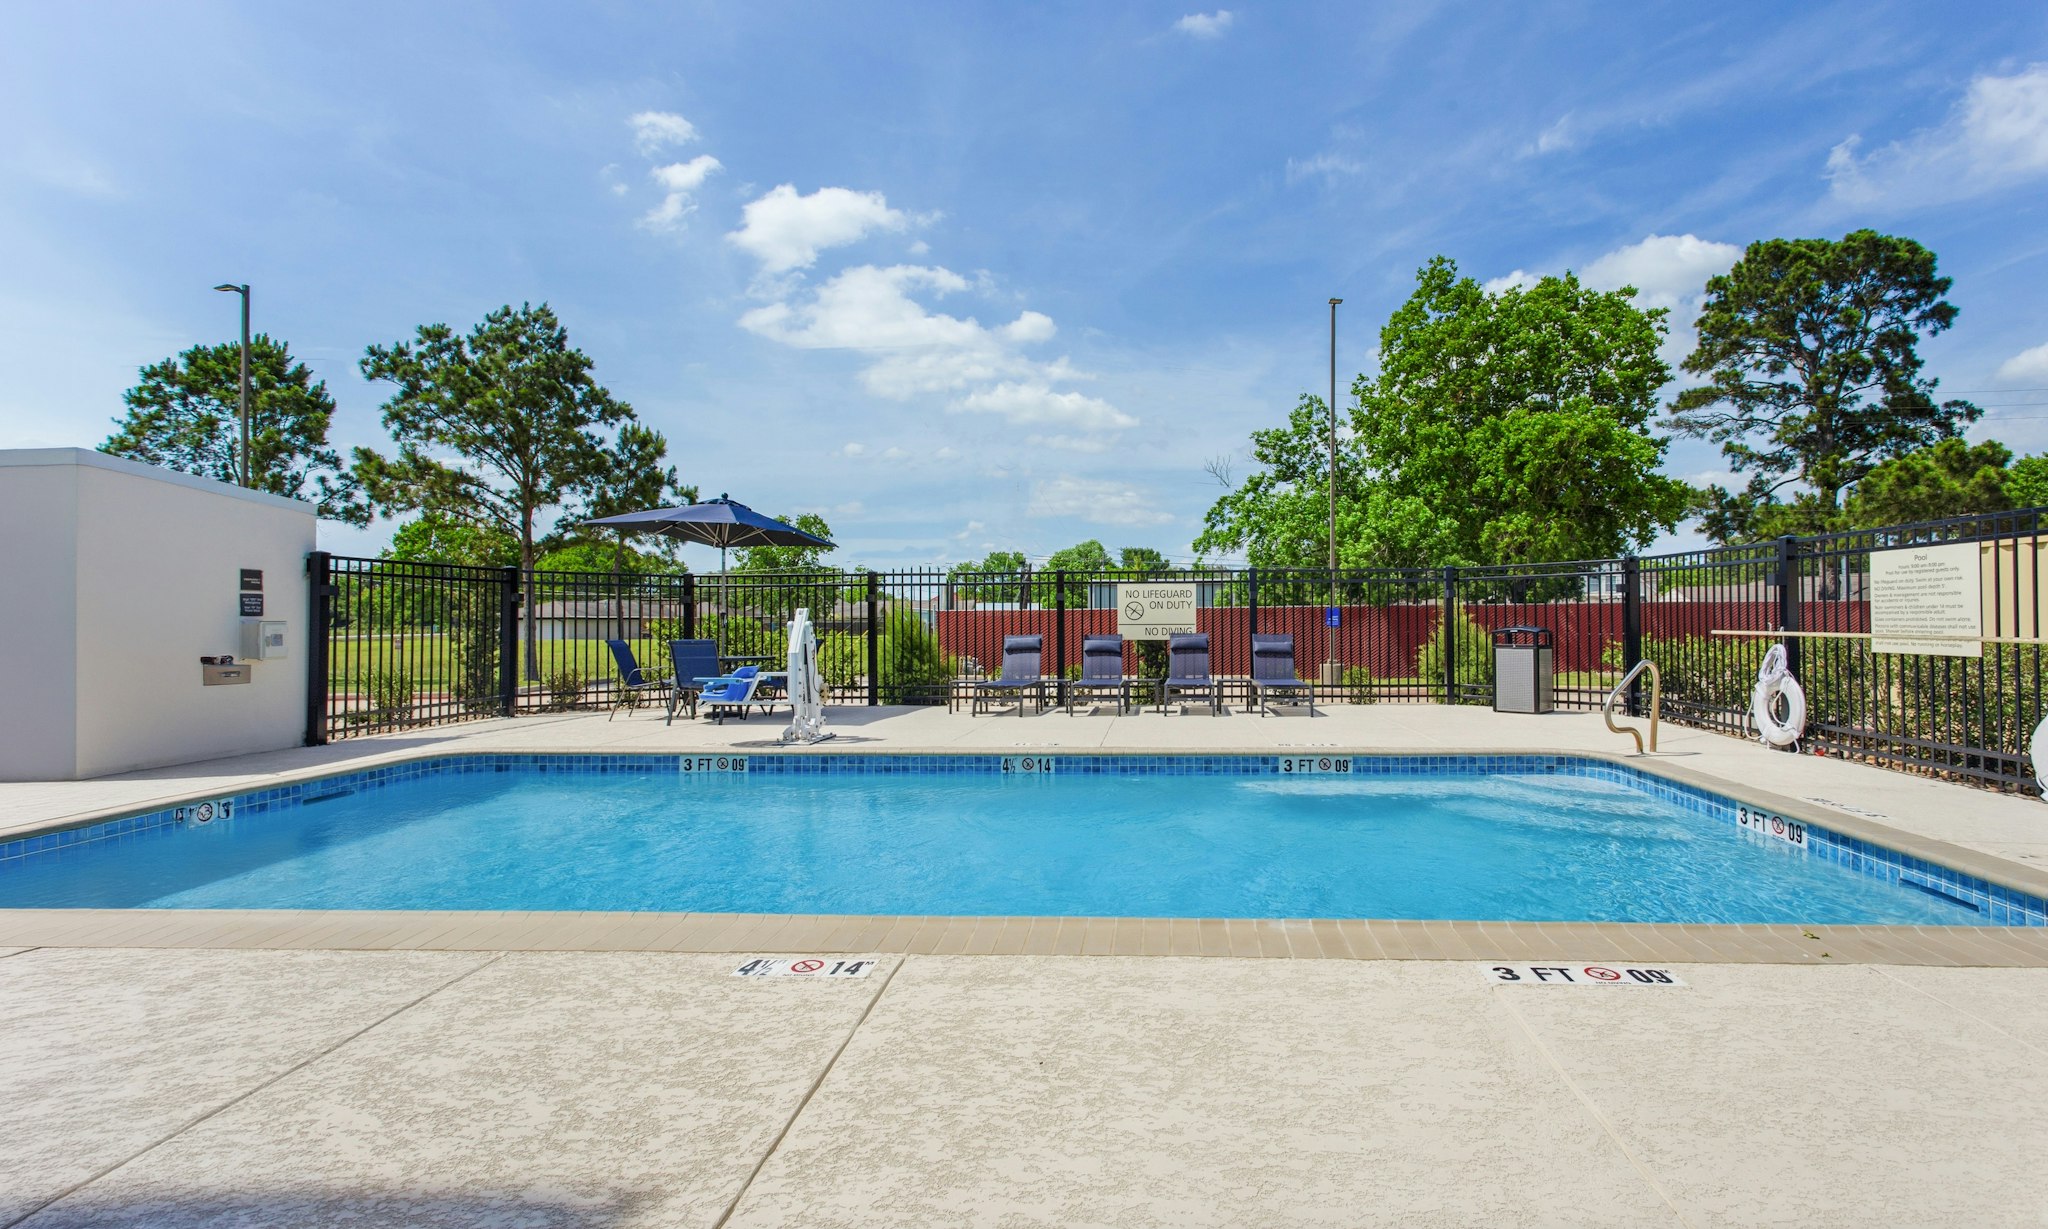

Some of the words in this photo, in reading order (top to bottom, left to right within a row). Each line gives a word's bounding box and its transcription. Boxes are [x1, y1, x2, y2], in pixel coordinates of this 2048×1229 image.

[1125, 590, 1140, 598] NO
[1142, 590, 1192, 598] LIFEGUARD
[1149, 601, 1164, 610] ON
[1167, 601, 1192, 610] DUTY
[1145, 627, 1159, 636] NO
[1161, 627, 1193, 636] DIVING
[684, 758, 692, 771] 3
[698, 758, 712, 771] FT
[1284, 759, 1293, 772] 3
[1299, 759, 1314, 772] FT
[1740, 807, 1748, 825] 3
[1753, 811, 1767, 832] FT
[1492, 967, 1521, 980] 3
[1530, 967, 1575, 982] FT
